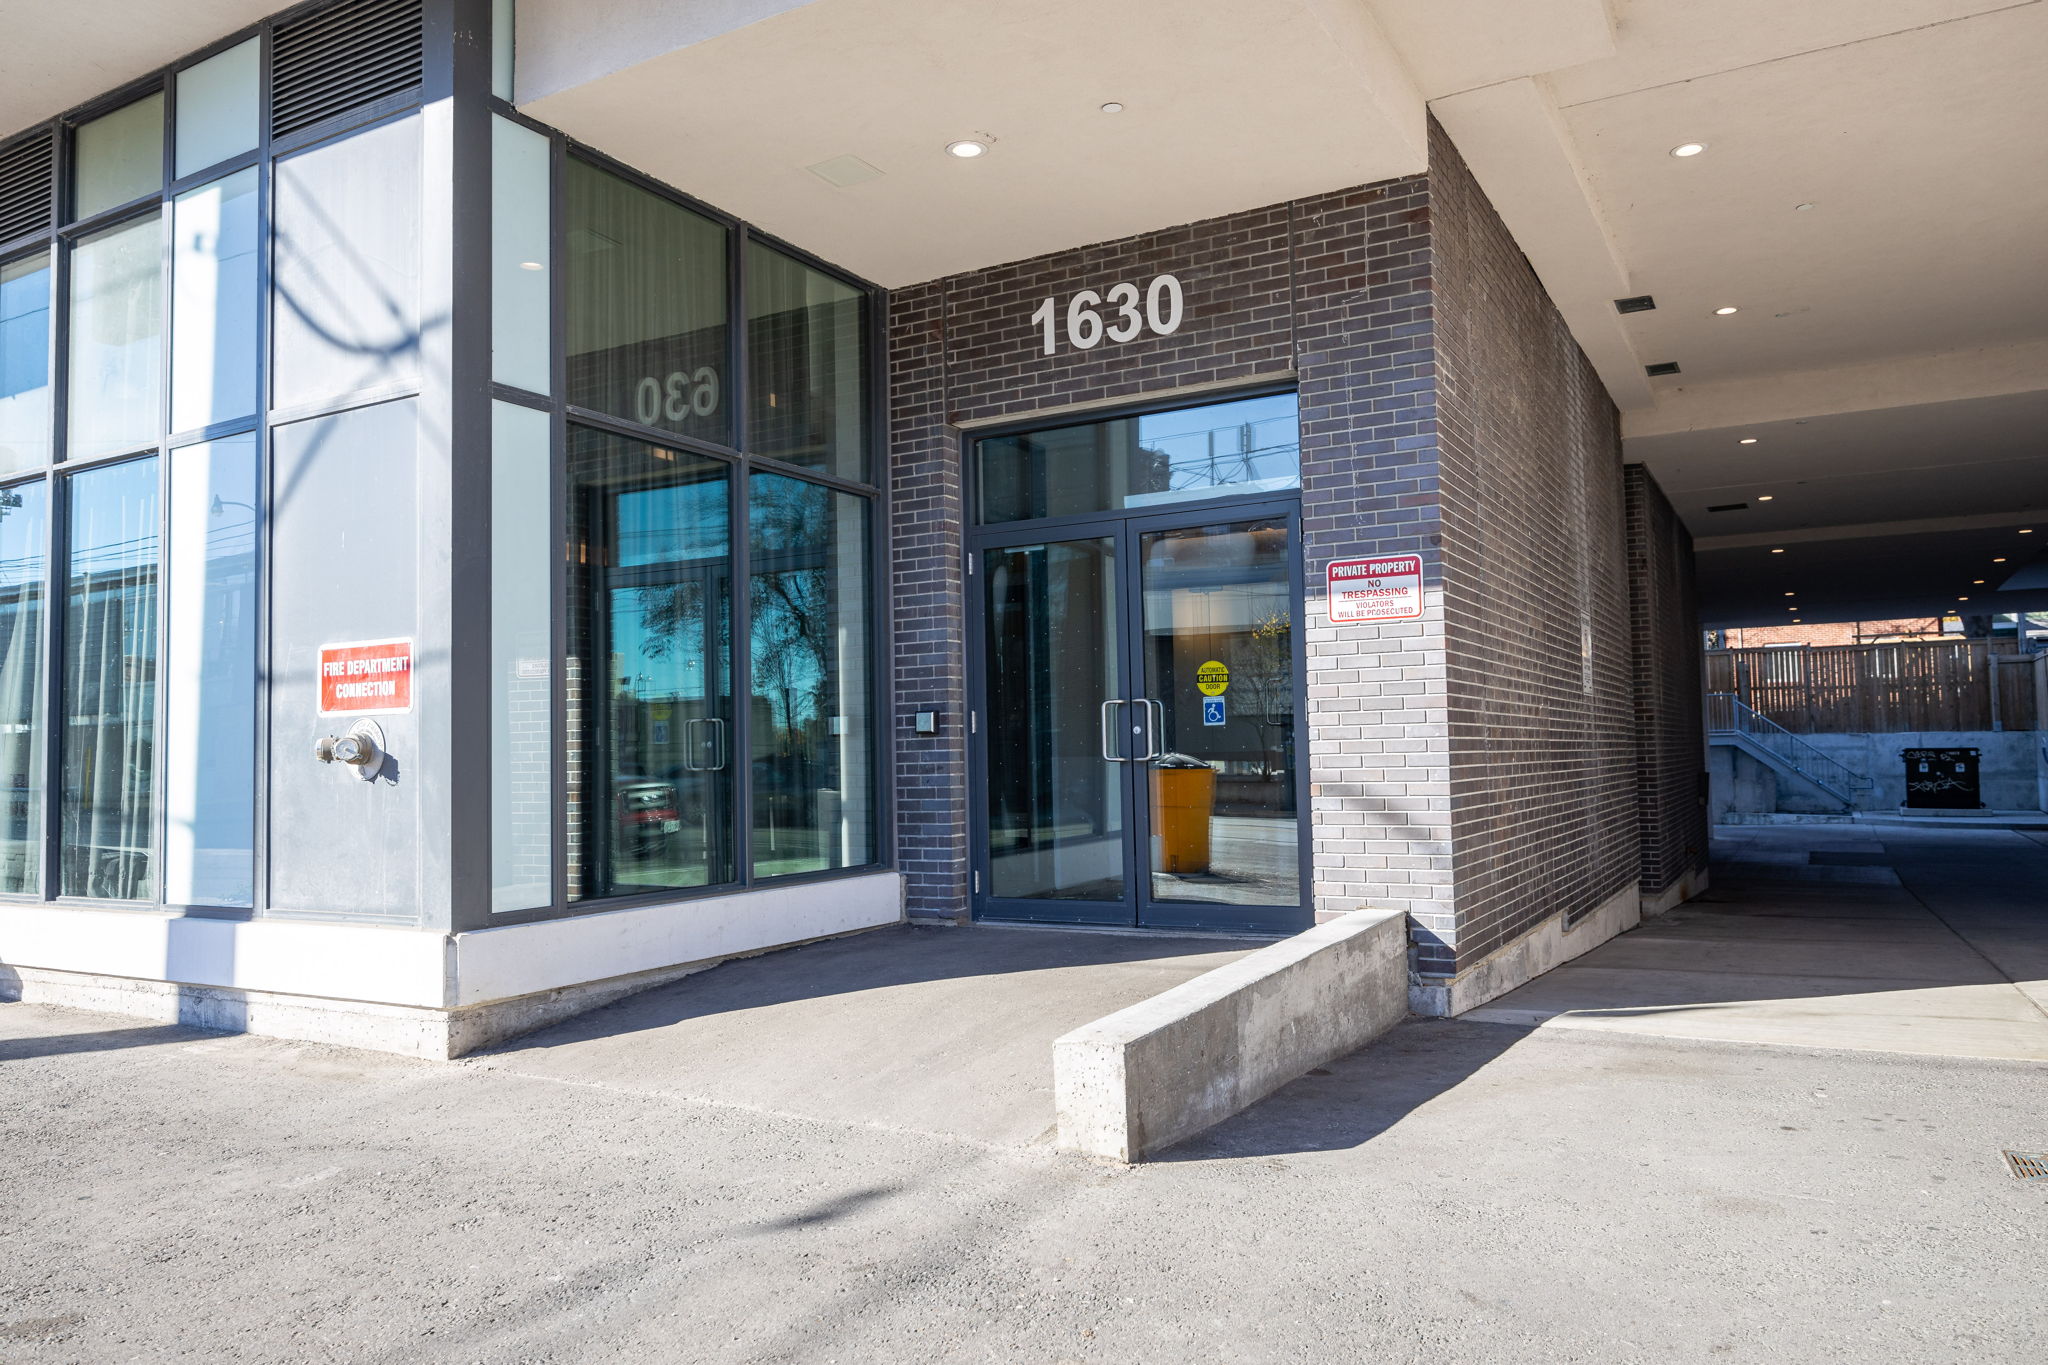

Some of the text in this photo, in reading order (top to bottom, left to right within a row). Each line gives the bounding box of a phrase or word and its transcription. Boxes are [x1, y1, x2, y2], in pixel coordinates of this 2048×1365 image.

[1031, 274, 1184, 356] 1630
[1332, 560, 1416, 578] PRIVATE PROPERTY
[1367, 579, 1382, 588] NO
[1341, 587, 1409, 599] TRESPASSING
[1355, 600, 1395, 609] VIOLATORS
[1337, 606, 1414, 618] WILL BE PROSECUTED
[323, 655, 409, 677] FIRE DEPARTMENT
[1198, 674, 1228, 682] CAUTION
[335, 680, 396, 699] CONNECTION
